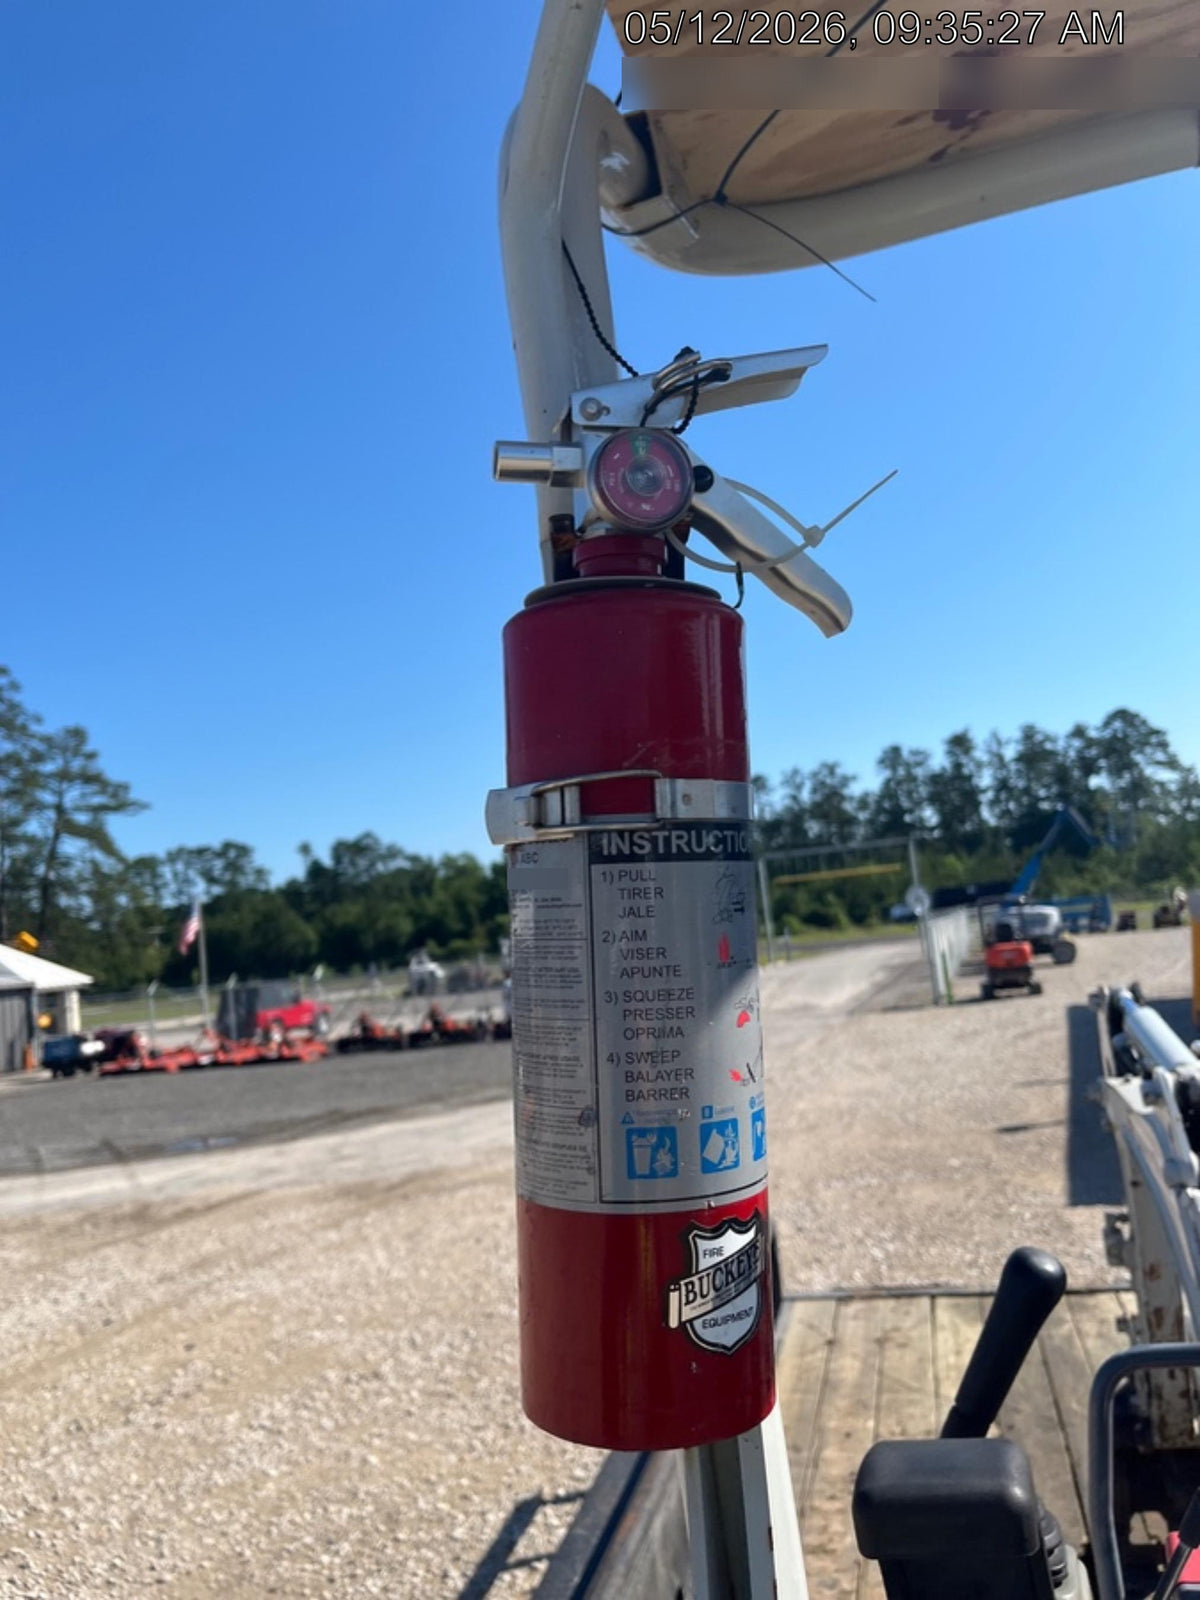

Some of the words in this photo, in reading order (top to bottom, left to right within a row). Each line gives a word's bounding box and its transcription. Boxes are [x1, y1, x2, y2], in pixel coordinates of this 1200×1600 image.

[601, 870, 614, 885] 1)
[618, 869, 656, 882] PULL
[618, 887, 664, 900] TIRER
[618, 906, 656, 918] JALE
[602, 930, 616, 945] 2)
[620, 929, 647, 942] AIM
[620, 947, 667, 960] VISER
[620, 964, 682, 979] APUNTE
[604, 991, 619, 1005] 3)
[623, 988, 695, 1004] SQUEEZE
[623, 1007, 696, 1022] PRESSER
[623, 1026, 685, 1040] OPRIMA
[606, 1054, 621, 1067] 4)
[625, 1050, 681, 1065] SWEEP
[625, 1068, 695, 1083] BALAYER
[625, 1087, 690, 1102] BARRER
[703, 1246, 725, 1259] FIRE
[702, 1306, 754, 1329] EQUIPMENT
